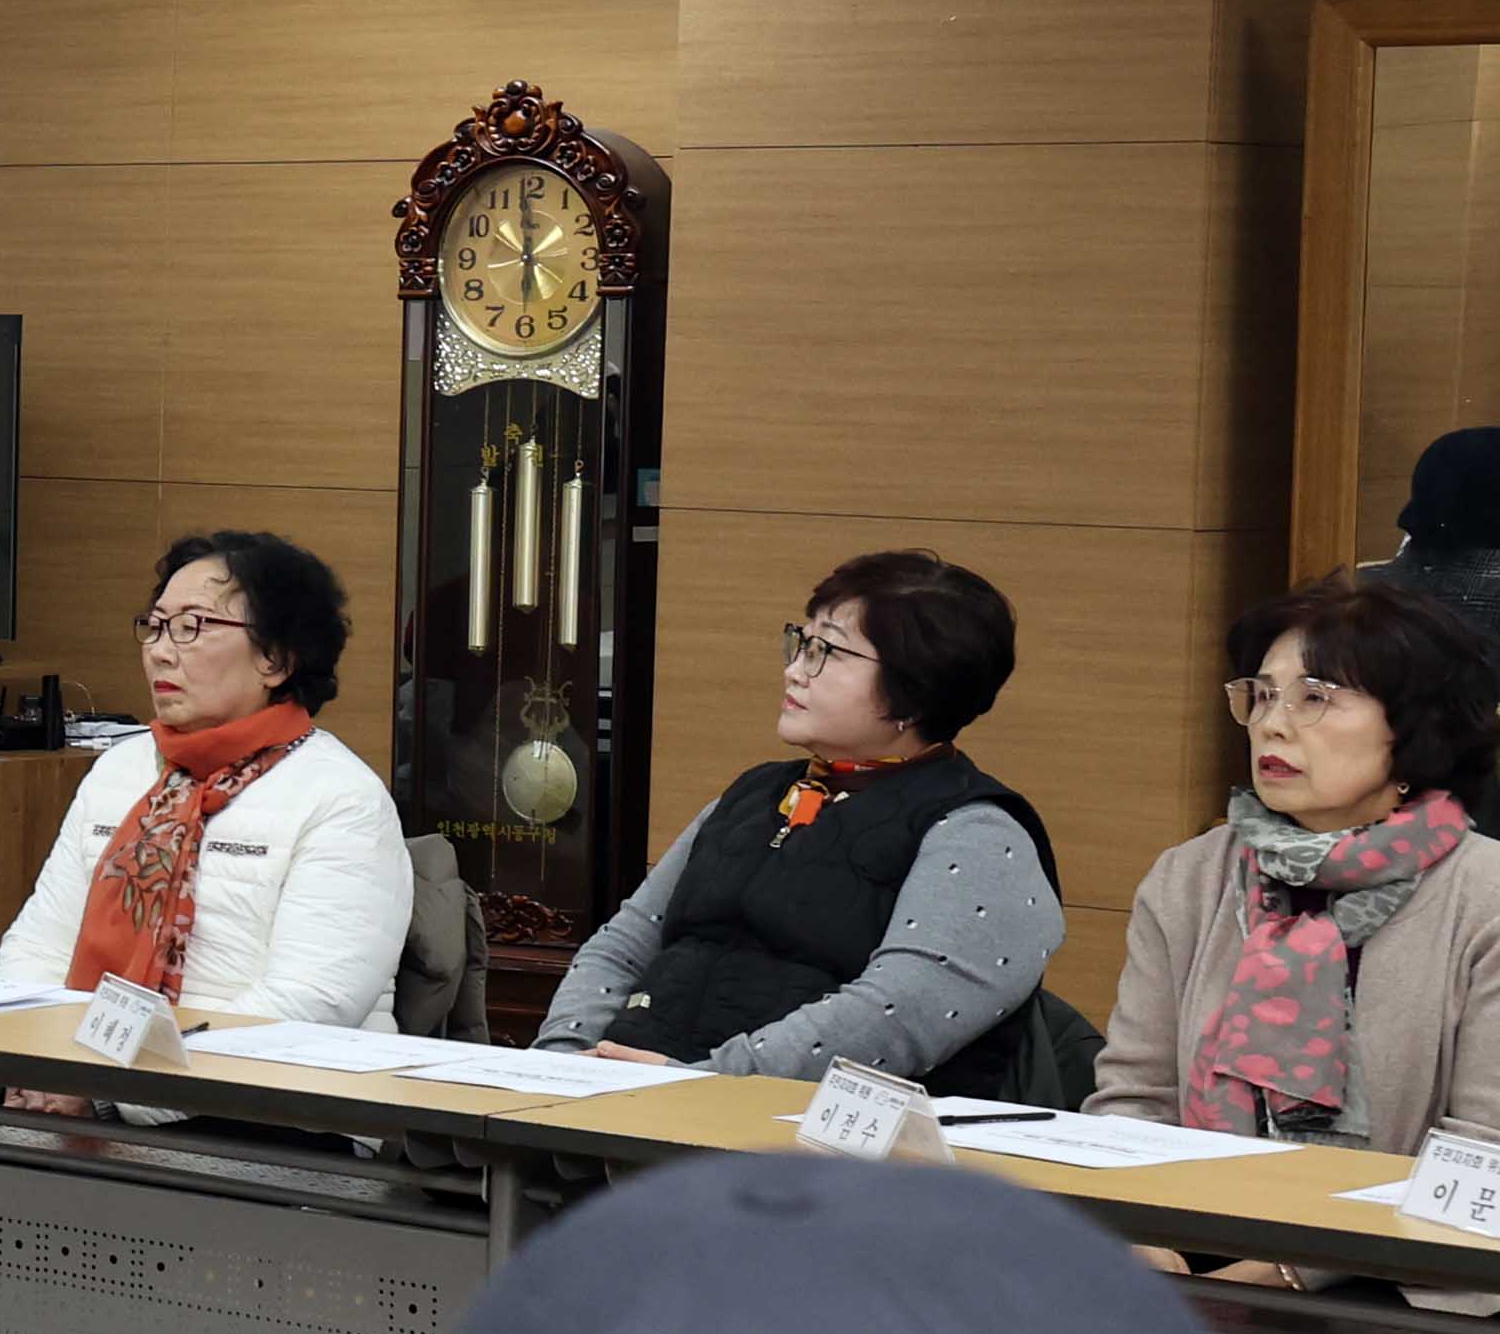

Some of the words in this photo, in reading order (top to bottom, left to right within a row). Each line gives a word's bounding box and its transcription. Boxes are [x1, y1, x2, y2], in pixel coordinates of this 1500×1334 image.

[489, 188, 509, 209] 11
[561, 188, 569, 210] 1
[468, 214, 490, 237] 10
[574, 213, 594, 236] 2
[458, 248, 476, 270] 9
[581, 247, 598, 271] 3
[463, 278, 484, 301] 8
[568, 279, 589, 302] 4
[485, 305, 504, 327] 7
[515, 315, 535, 338] 6
[547, 305, 568, 330] 5
